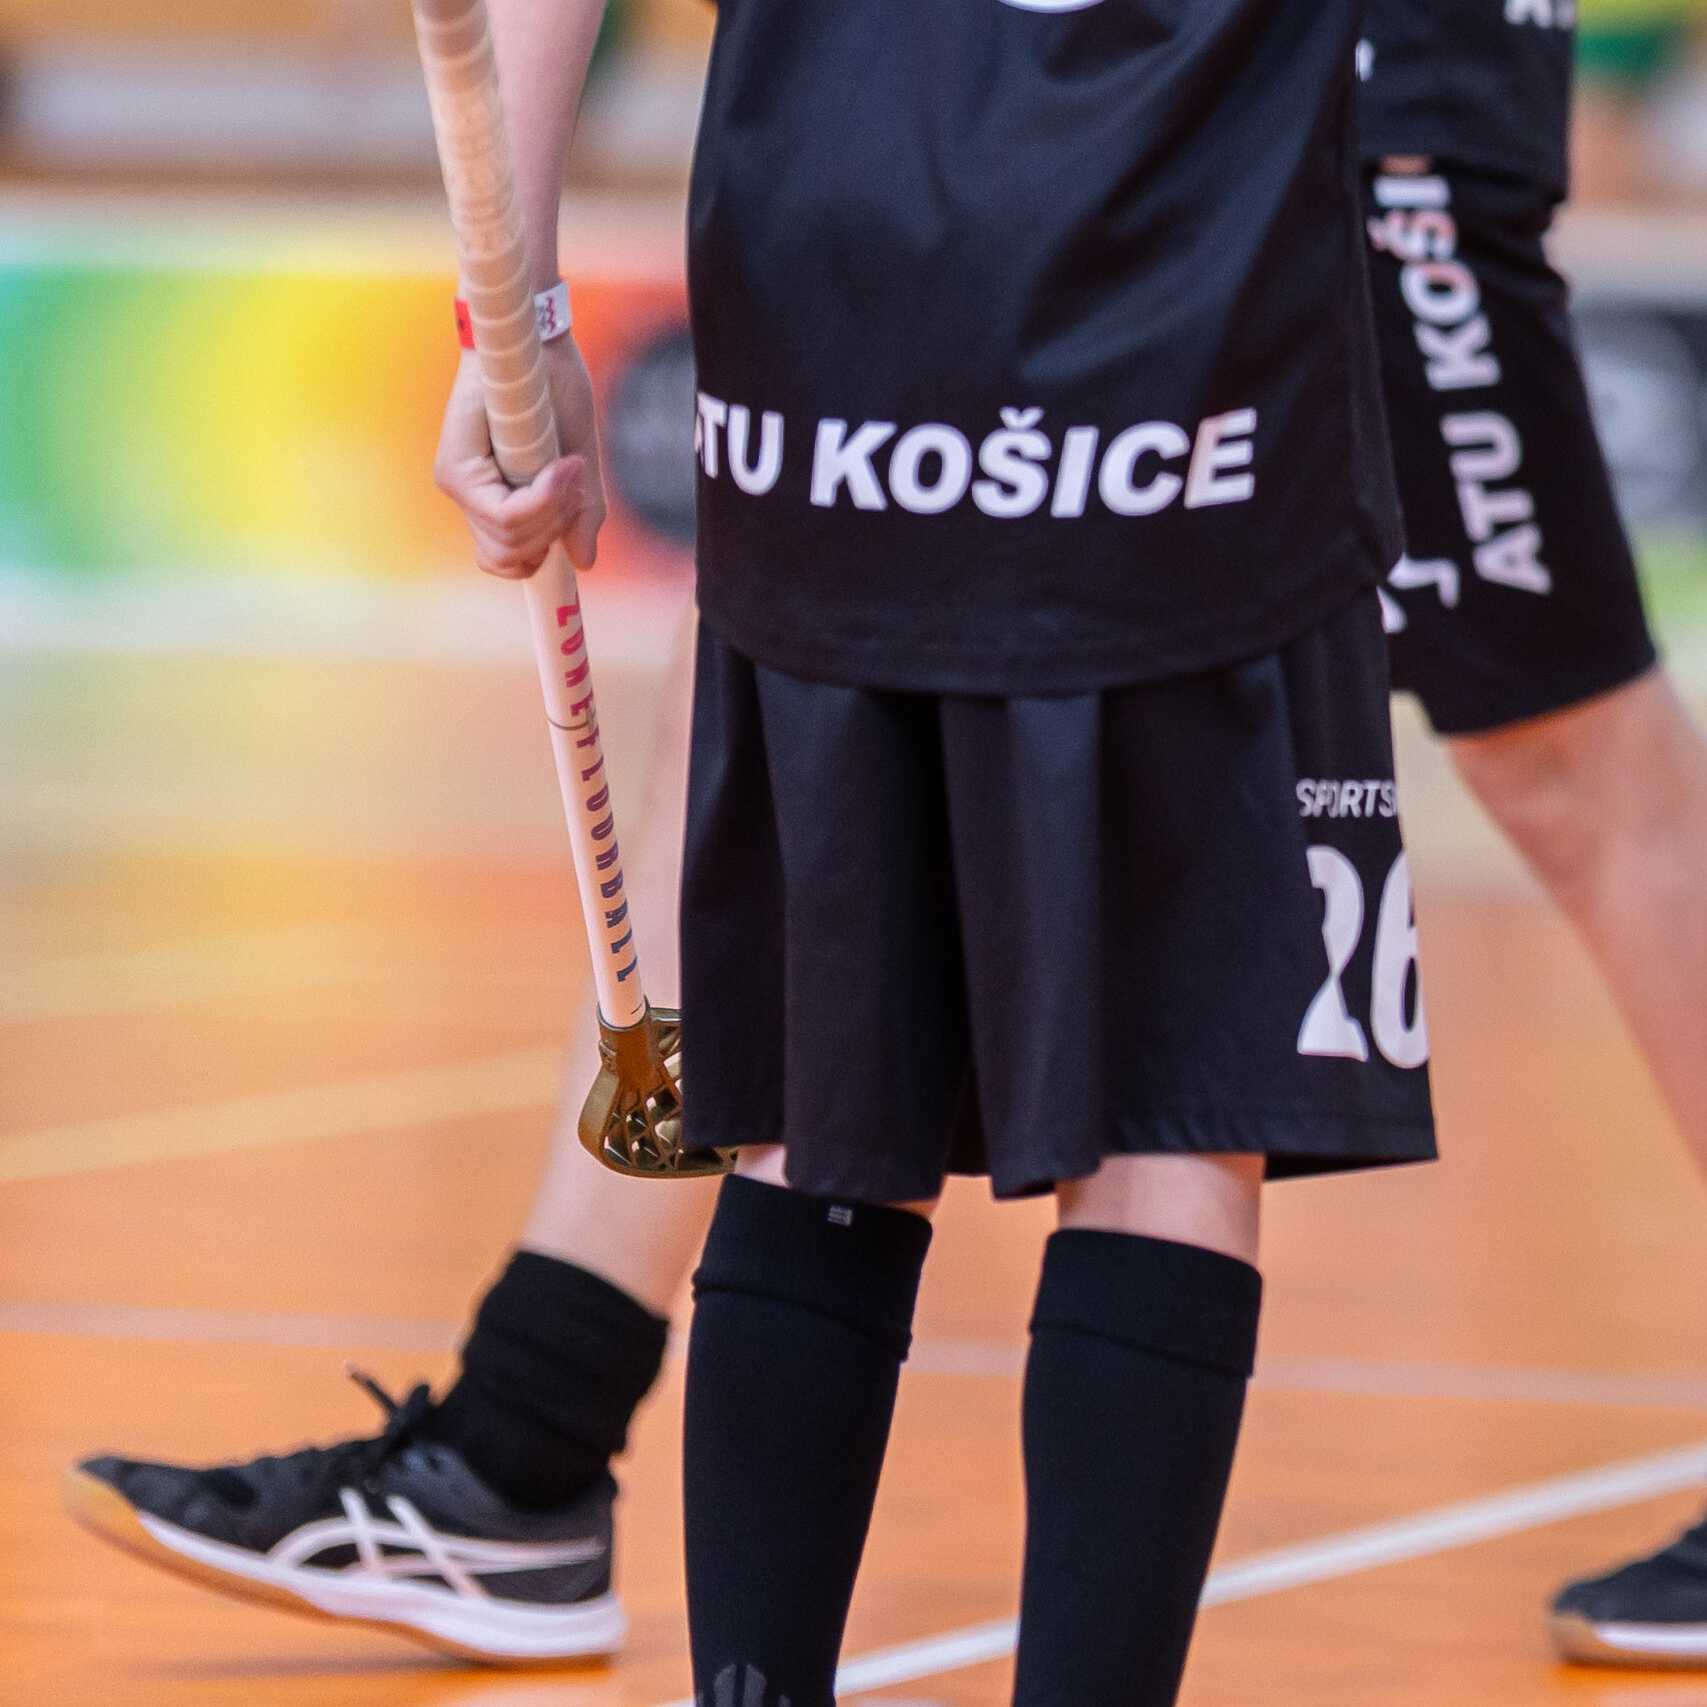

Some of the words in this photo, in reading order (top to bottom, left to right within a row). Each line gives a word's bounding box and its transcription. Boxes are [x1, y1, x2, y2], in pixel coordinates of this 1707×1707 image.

[1368, 155, 1501, 391] KOŠI
[810, 404, 1258, 519] KOŠICE
[1440, 410, 1552, 593] ATU
[1297, 844, 1430, 1070] 26
